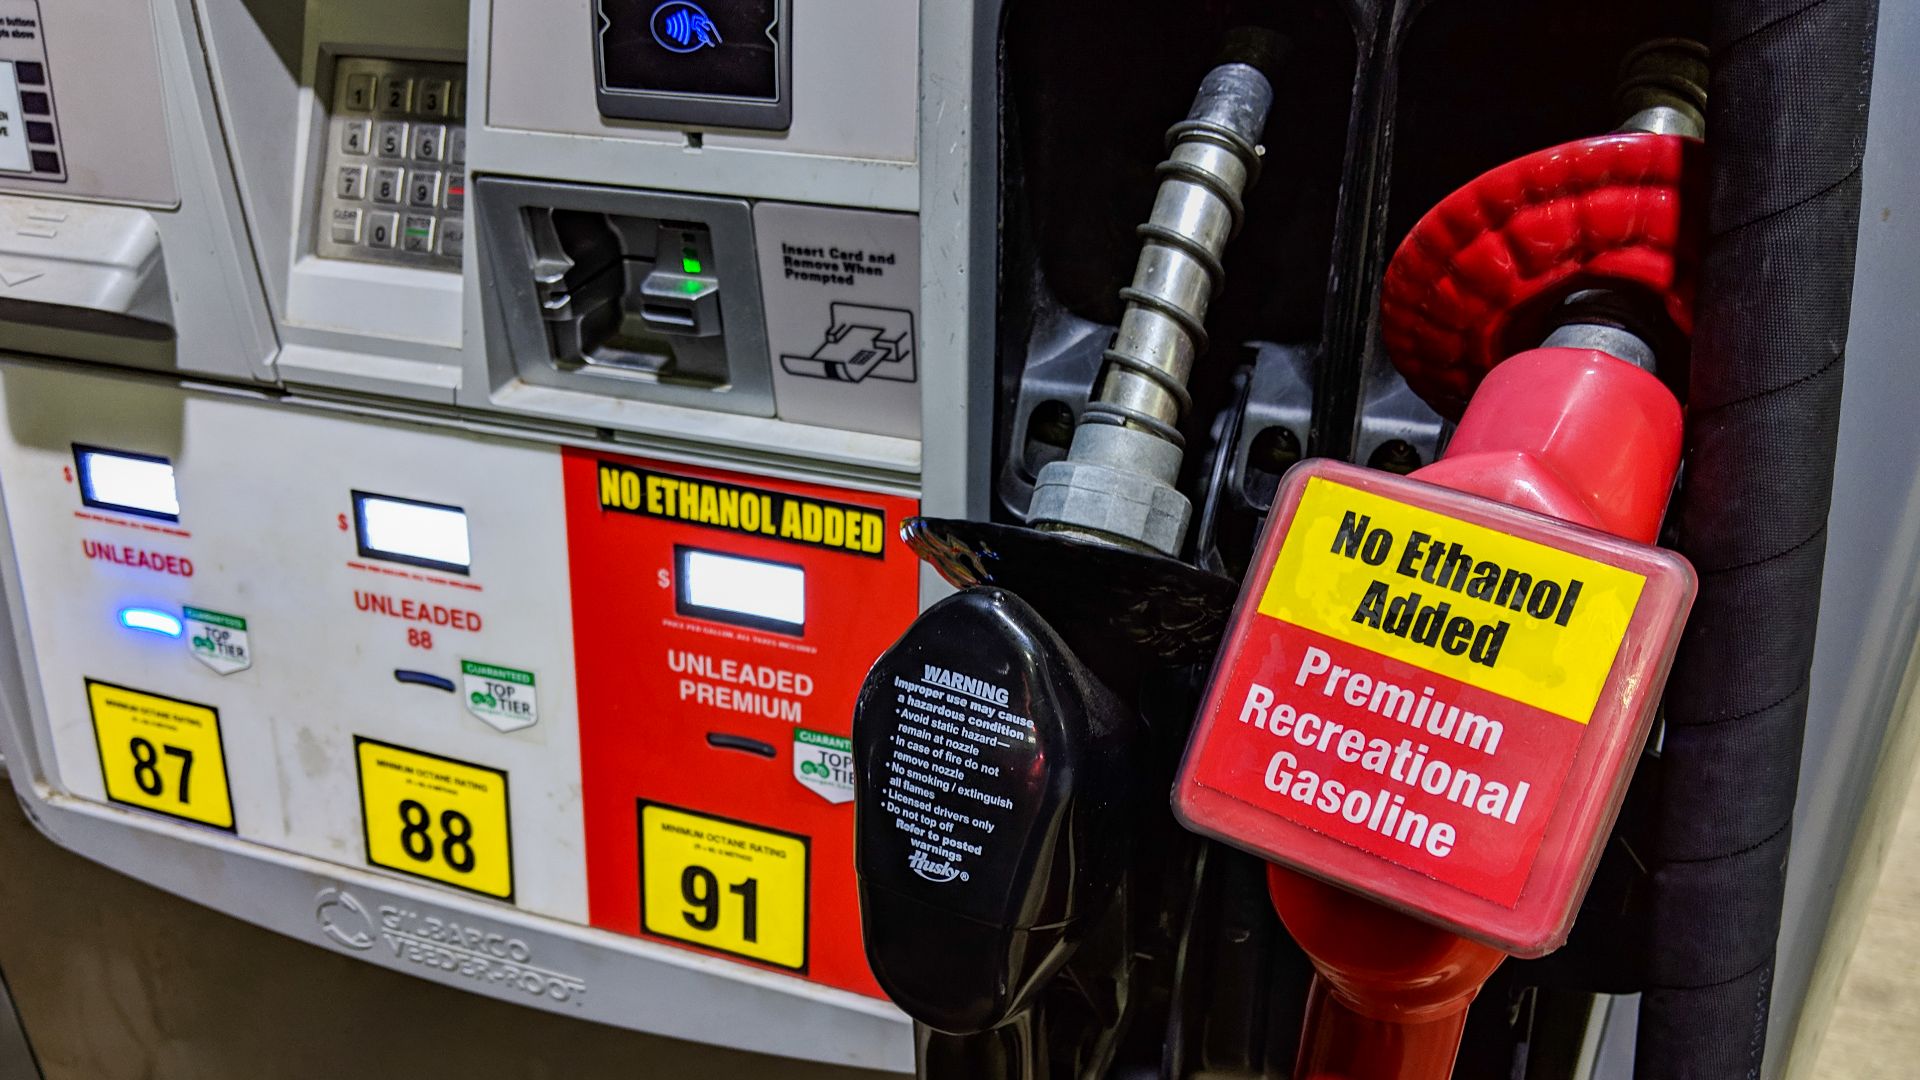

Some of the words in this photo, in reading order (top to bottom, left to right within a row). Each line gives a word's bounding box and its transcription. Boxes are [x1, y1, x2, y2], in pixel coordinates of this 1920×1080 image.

[11, 29, 35, 40] above
[354, 89, 362, 105] 1
[390, 91, 400, 108] 2
[426, 94, 436, 111] 3
[348, 134, 358, 149] 4
[385, 136, 396, 153] 5
[422, 139, 433, 157] 6
[344, 177, 354, 195] 7
[380, 180, 391, 198] 8
[417, 184, 428, 202] 9
[374, 226, 386, 243] 0
[782, 243, 824, 258] Insert
[829, 248, 864, 262] Card
[868, 253, 896, 265] and
[783, 255, 840, 272] Remove
[842, 262, 883, 276] When
[785, 267, 855, 286] Prompted
[338, 513, 348, 532] $
[600, 467, 640, 510] NO
[646, 475, 776, 536] ETHANOL
[780, 500, 884, 555] ADDED
[82, 539, 194, 578] UNLEADED
[1330, 510, 1394, 567] No
[1396, 530, 1584, 628] Ethanol
[657, 567, 671, 590] $
[353, 590, 483, 633] UNLEADED
[1351, 579, 1511, 668] Added
[205, 626, 230, 643] TOP
[217, 643, 244, 657] TIER
[407, 628, 433, 650] 88
[466, 663, 530, 685] GUARANTEED
[667, 649, 814, 697] UNLEADED
[923, 664, 1009, 704] WARNING
[485, 682, 516, 698] TOP
[499, 698, 531, 715] TIER
[679, 679, 802, 723] PREMIUM
[894, 675, 945, 700] Improper
[946, 693, 968, 708] use
[969, 700, 996, 719] may
[997, 710, 1034, 729] cause
[1295, 645, 1505, 756] Premium
[897, 694, 905, 704] a
[907, 695, 966, 723] hazardous
[967, 716, 1025, 741] condition
[900, 708, 930, 726] Avoid
[930, 719, 960, 735] static
[897, 723, 932, 742] remain
[933, 735, 944, 745] at
[945, 738, 980, 756] nozzle
[1238, 682, 1531, 826] Recreational
[129, 736, 194, 805] 87
[818, 750, 853, 769] TOP
[893, 750, 930, 770] remove
[931, 763, 965, 781] nozzle
[895, 735, 906, 748] In
[906, 740, 931, 756] case
[932, 748, 945, 760] of
[945, 750, 963, 766] fire
[964, 758, 979, 771] do
[980, 763, 1000, 778] not
[889, 776, 902, 788] all
[902, 779, 936, 800] flames
[891, 761, 906, 776] No
[906, 768, 951, 793] smoking
[951, 782, 957, 793] /
[957, 785, 1014, 811] extinguish
[886, 801, 901, 815] Do
[902, 808, 919, 822] not
[920, 813, 937, 829] top
[938, 821, 955, 834] off
[888, 788, 932, 813] Licensed
[933, 805, 970, 825] drivers
[971, 818, 996, 835] only
[1263, 750, 1457, 858] Gasoline
[398, 799, 476, 874] 88
[660, 822, 704, 839] MINIMUM
[706, 833, 747, 850] OCTANE
[749, 842, 787, 859] RATING
[895, 818, 926, 837] Refer
[927, 829, 940, 842] to
[941, 836, 983, 856] posted
[910, 837, 963, 862] warnings
[681, 865, 758, 943] 91
